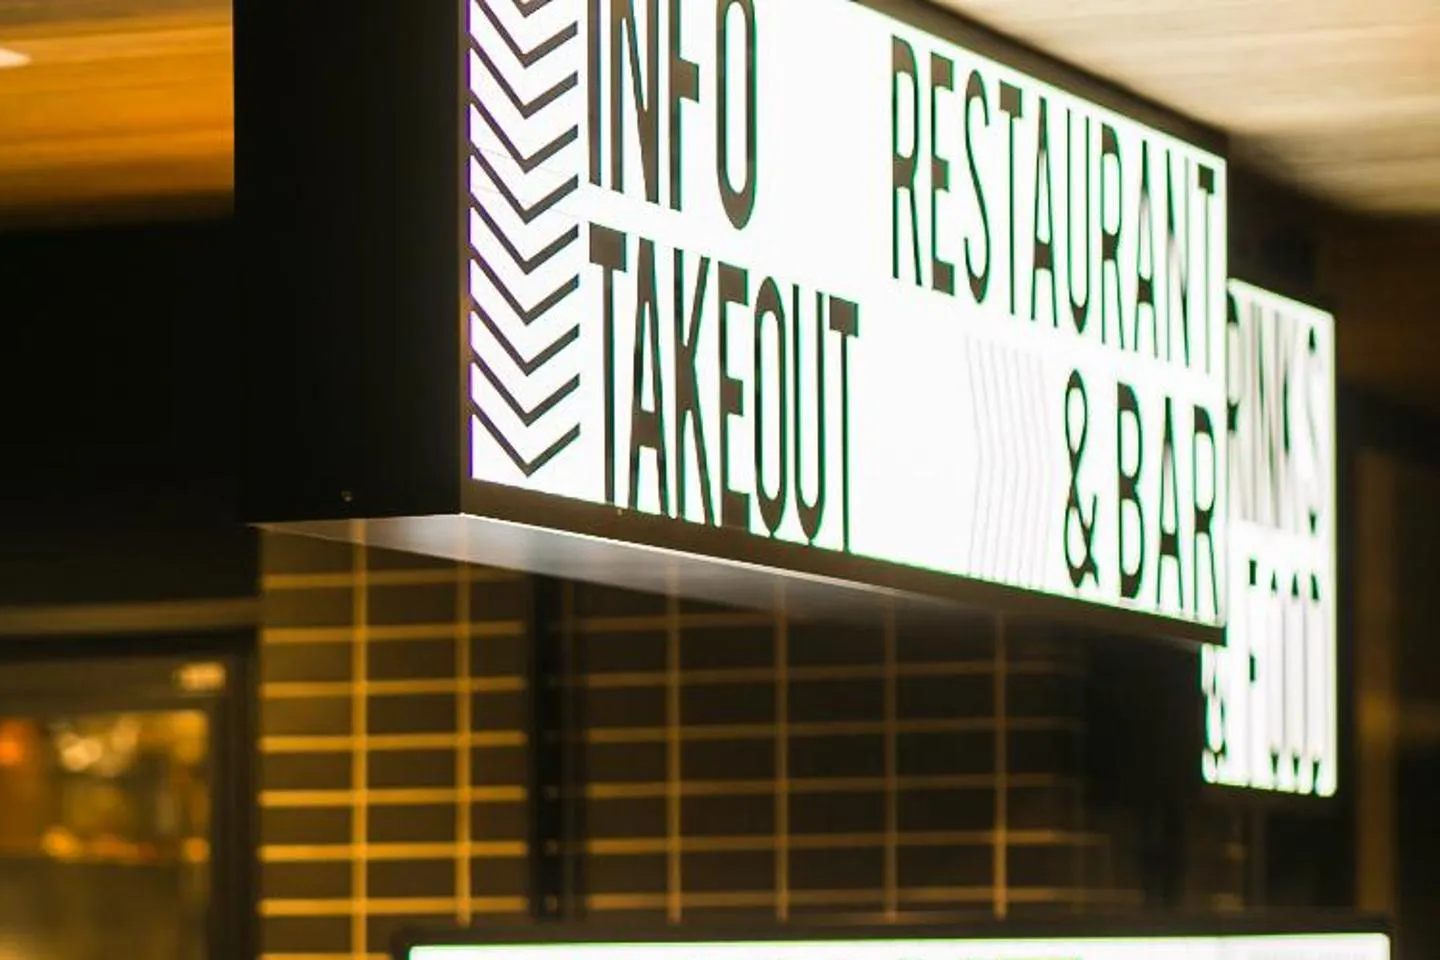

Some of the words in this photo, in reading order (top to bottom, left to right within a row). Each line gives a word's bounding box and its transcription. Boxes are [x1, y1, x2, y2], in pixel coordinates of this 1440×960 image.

[588, 0, 757, 230] INFO
[891, 34, 1216, 375] RESTAURANT
[588, 222, 859, 553] TAKEOUT
[1063, 368, 1100, 589] &
[1117, 380, 1221, 618] BAR
